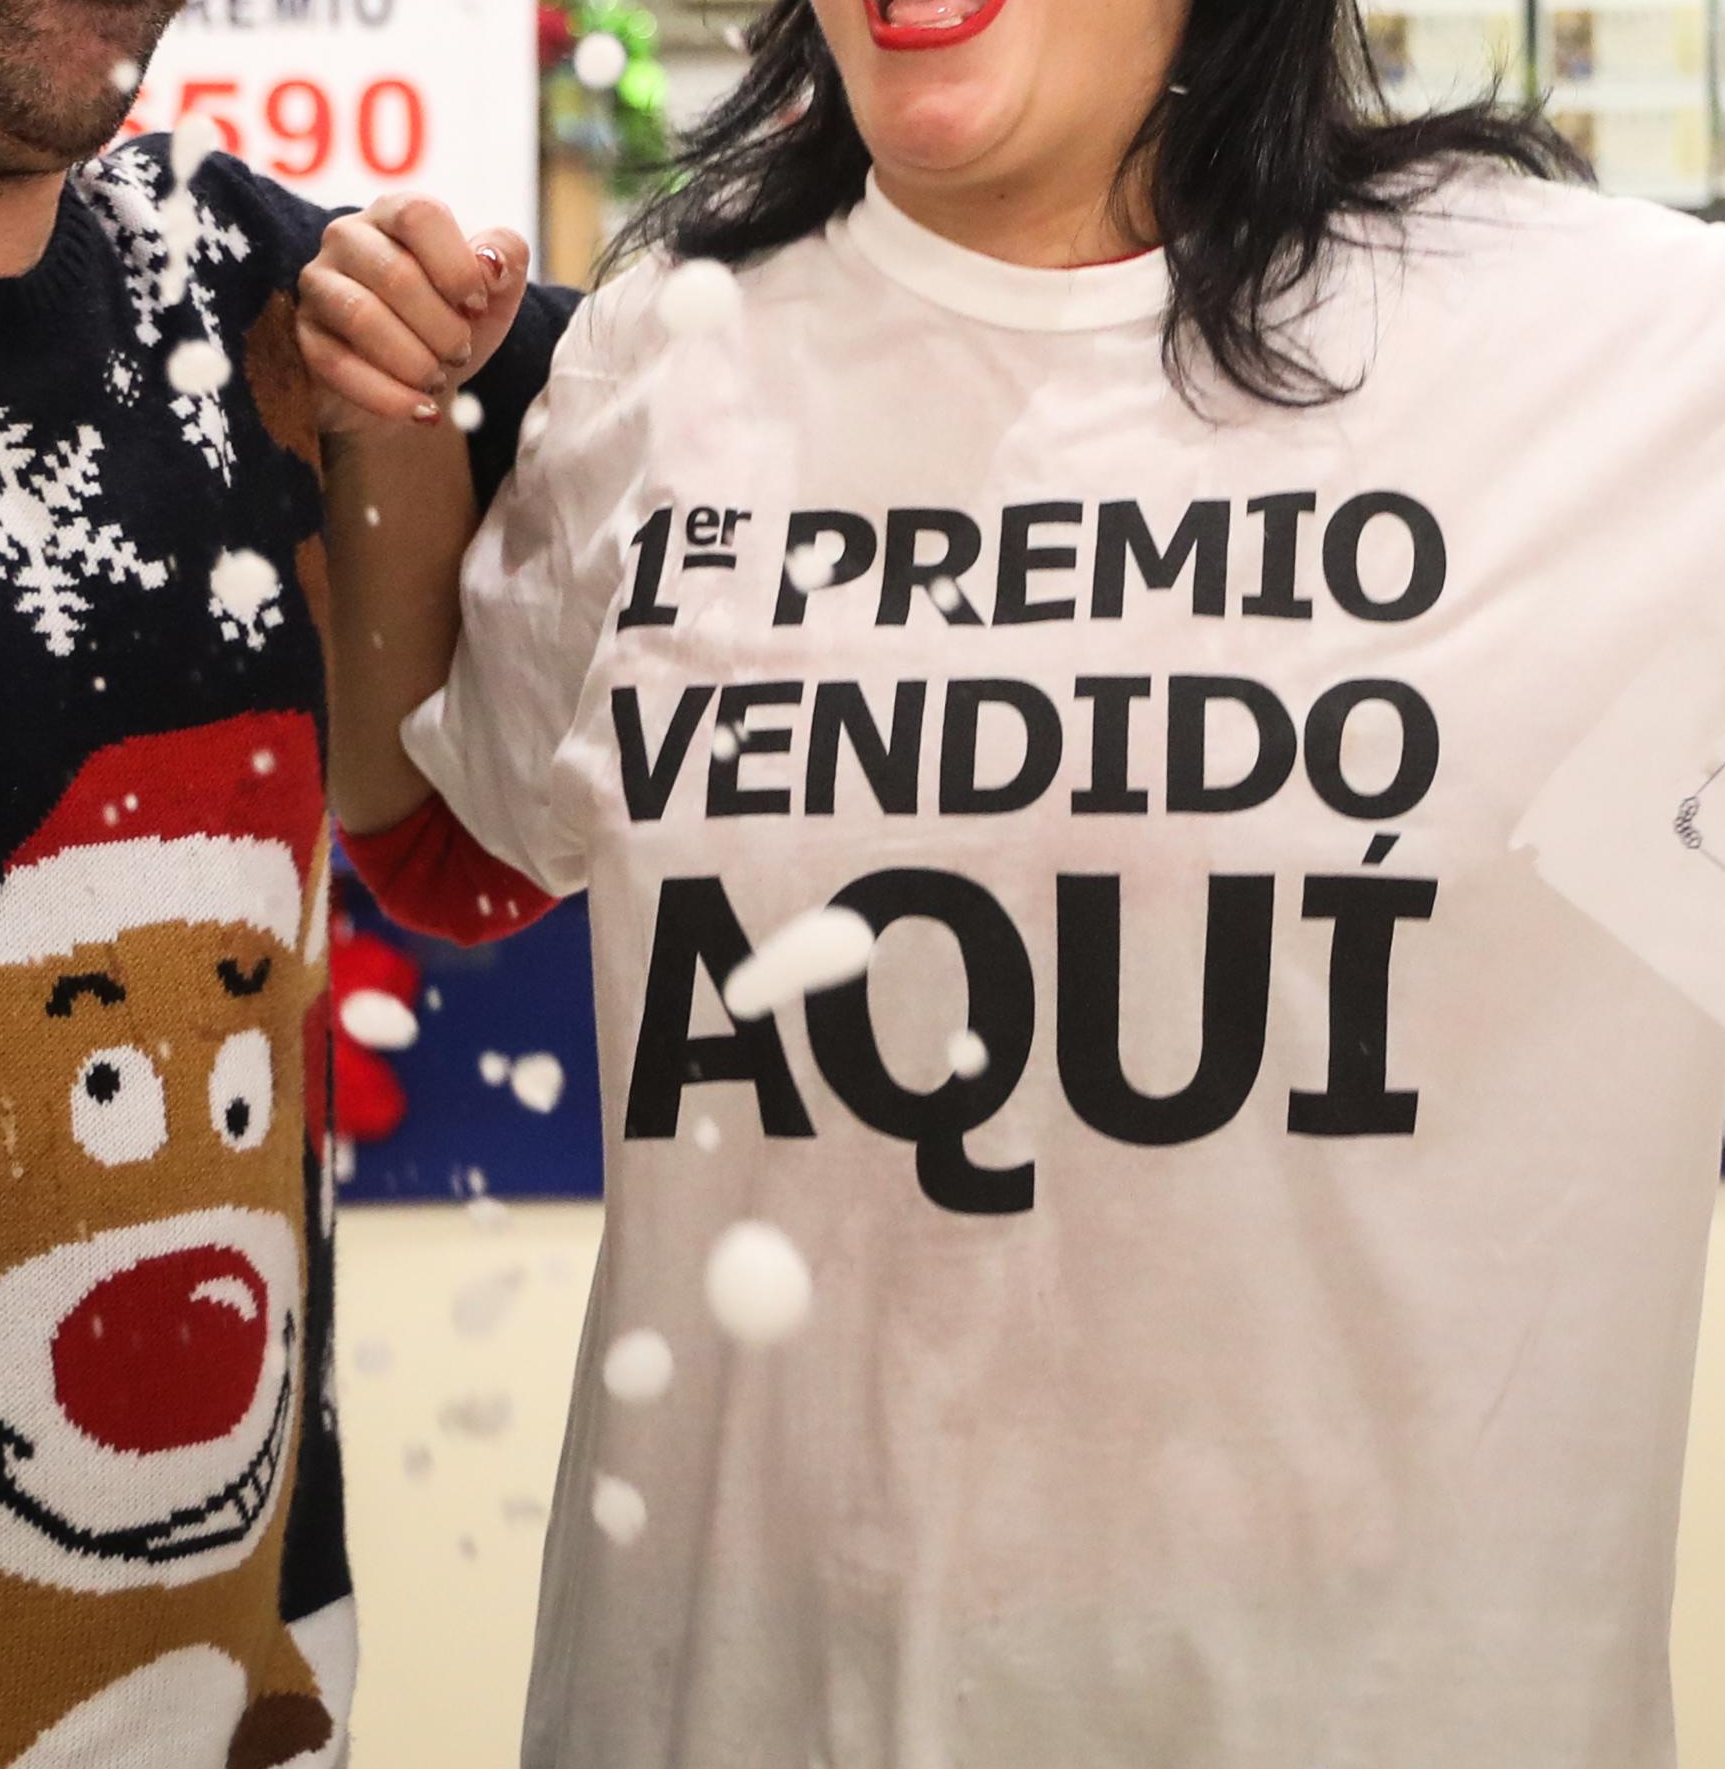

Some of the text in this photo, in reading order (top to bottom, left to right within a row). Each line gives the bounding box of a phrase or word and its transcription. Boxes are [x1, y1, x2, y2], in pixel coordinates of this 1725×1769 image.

[772, 489, 1448, 628] PREMIO
[610, 674, 1441, 822] VENDIDO
[624, 832, 1439, 1215] AQUÍ
